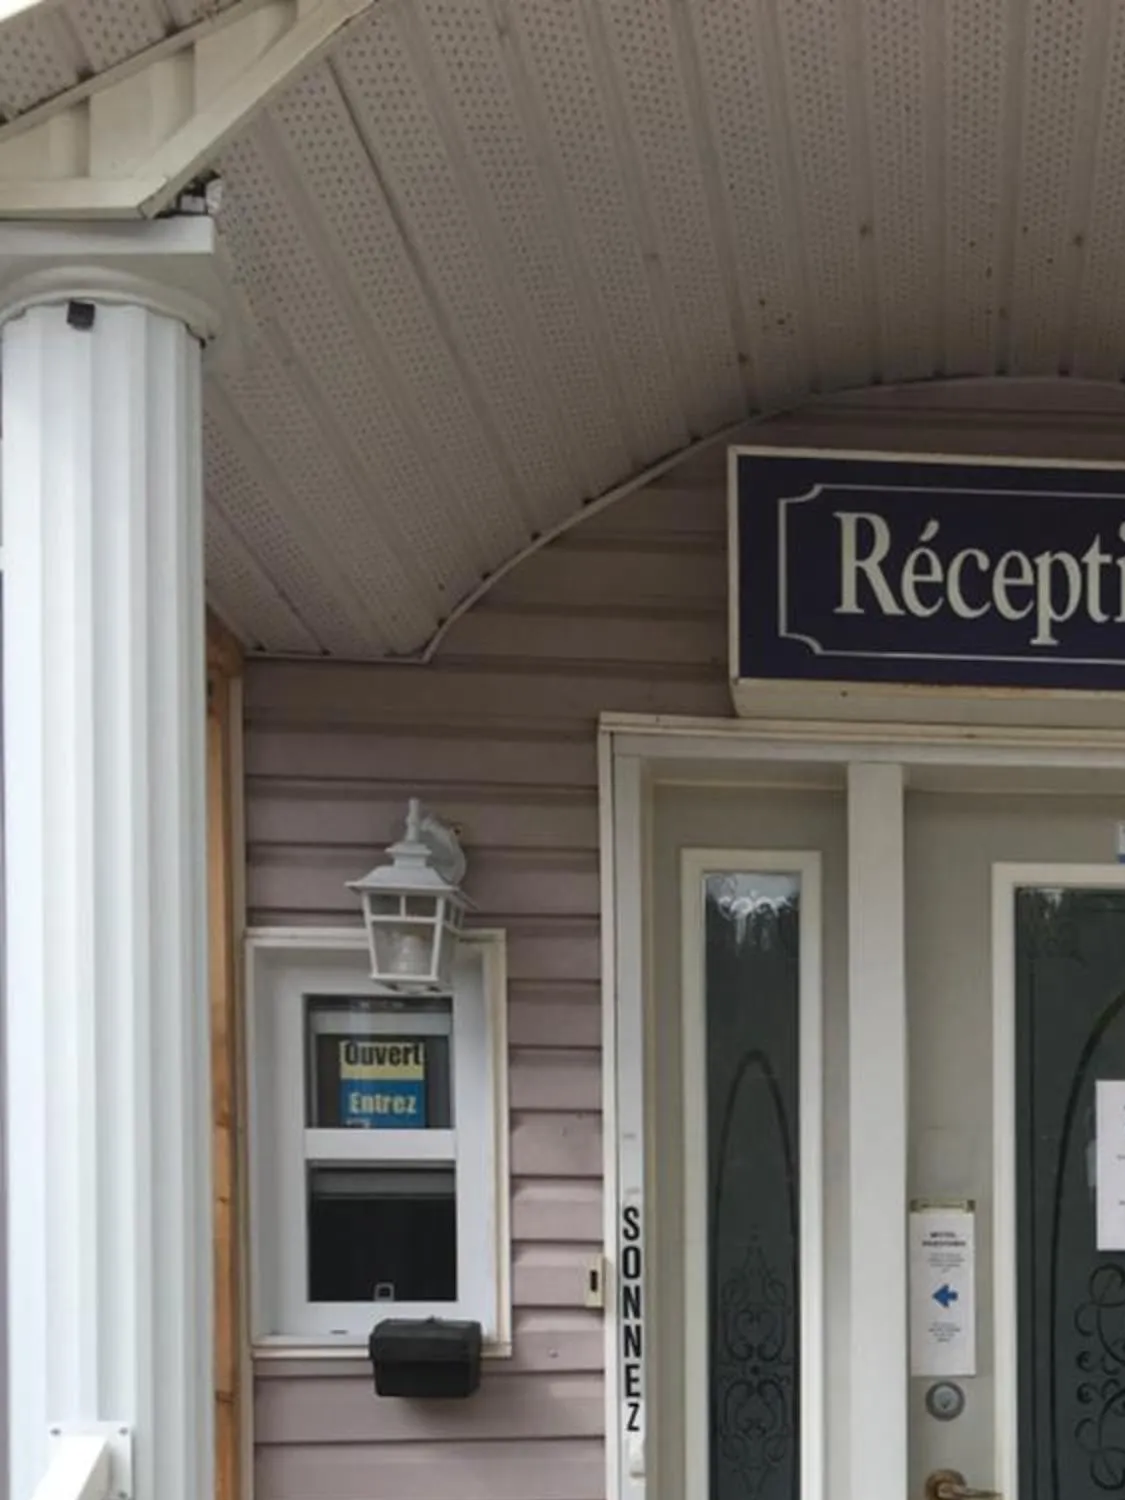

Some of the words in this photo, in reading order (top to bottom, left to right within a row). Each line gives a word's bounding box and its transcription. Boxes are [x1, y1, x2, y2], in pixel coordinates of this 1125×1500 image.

[344, 1041, 423, 1066] Ouvert
[348, 1092, 417, 1114] Entrez
[622, 1206, 642, 1432] SONNEZ
